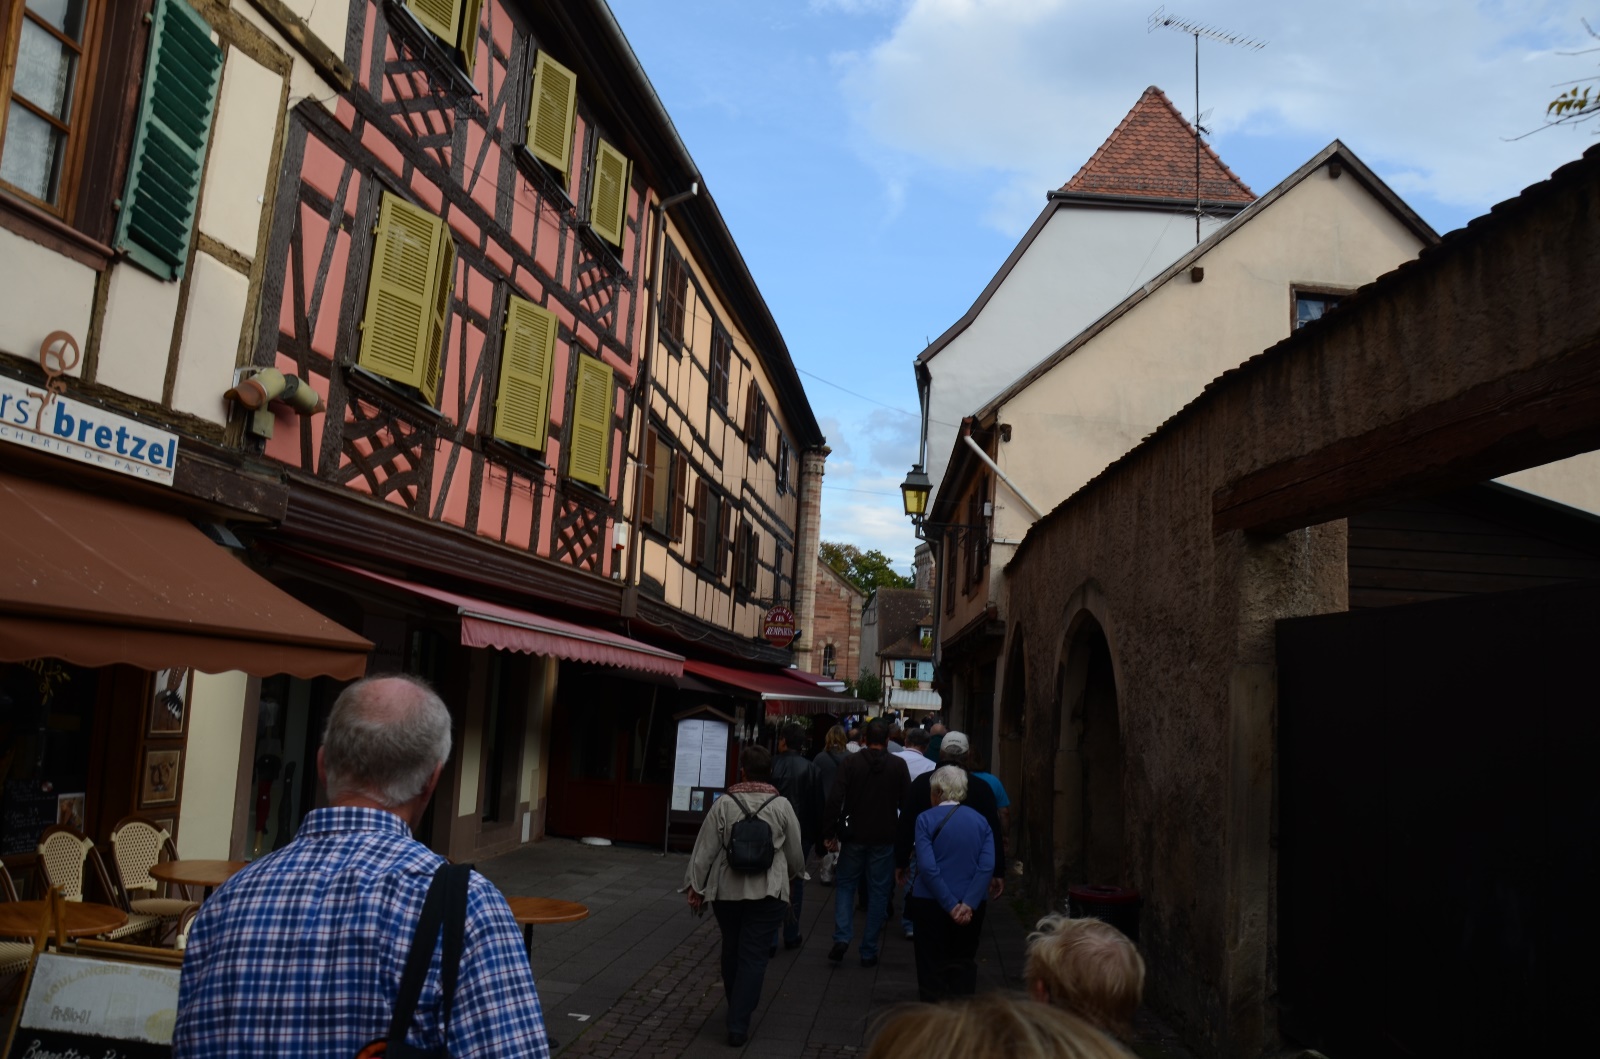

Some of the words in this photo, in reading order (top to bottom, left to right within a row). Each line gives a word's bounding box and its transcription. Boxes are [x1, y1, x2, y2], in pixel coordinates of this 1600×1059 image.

[0, 393, 29, 424] rs
[53, 401, 175, 468] bretzel
[1, 427, 72, 454] CHERIE
[85, 451, 103, 463] DE
[114, 460, 151, 476] PAYS
[766, 608, 793, 623] RESTAURANT
[775, 614, 785, 622] LES
[765, 626, 793, 636] REMPARTS
[43, 965, 132, 1004] BOULANGERIE
